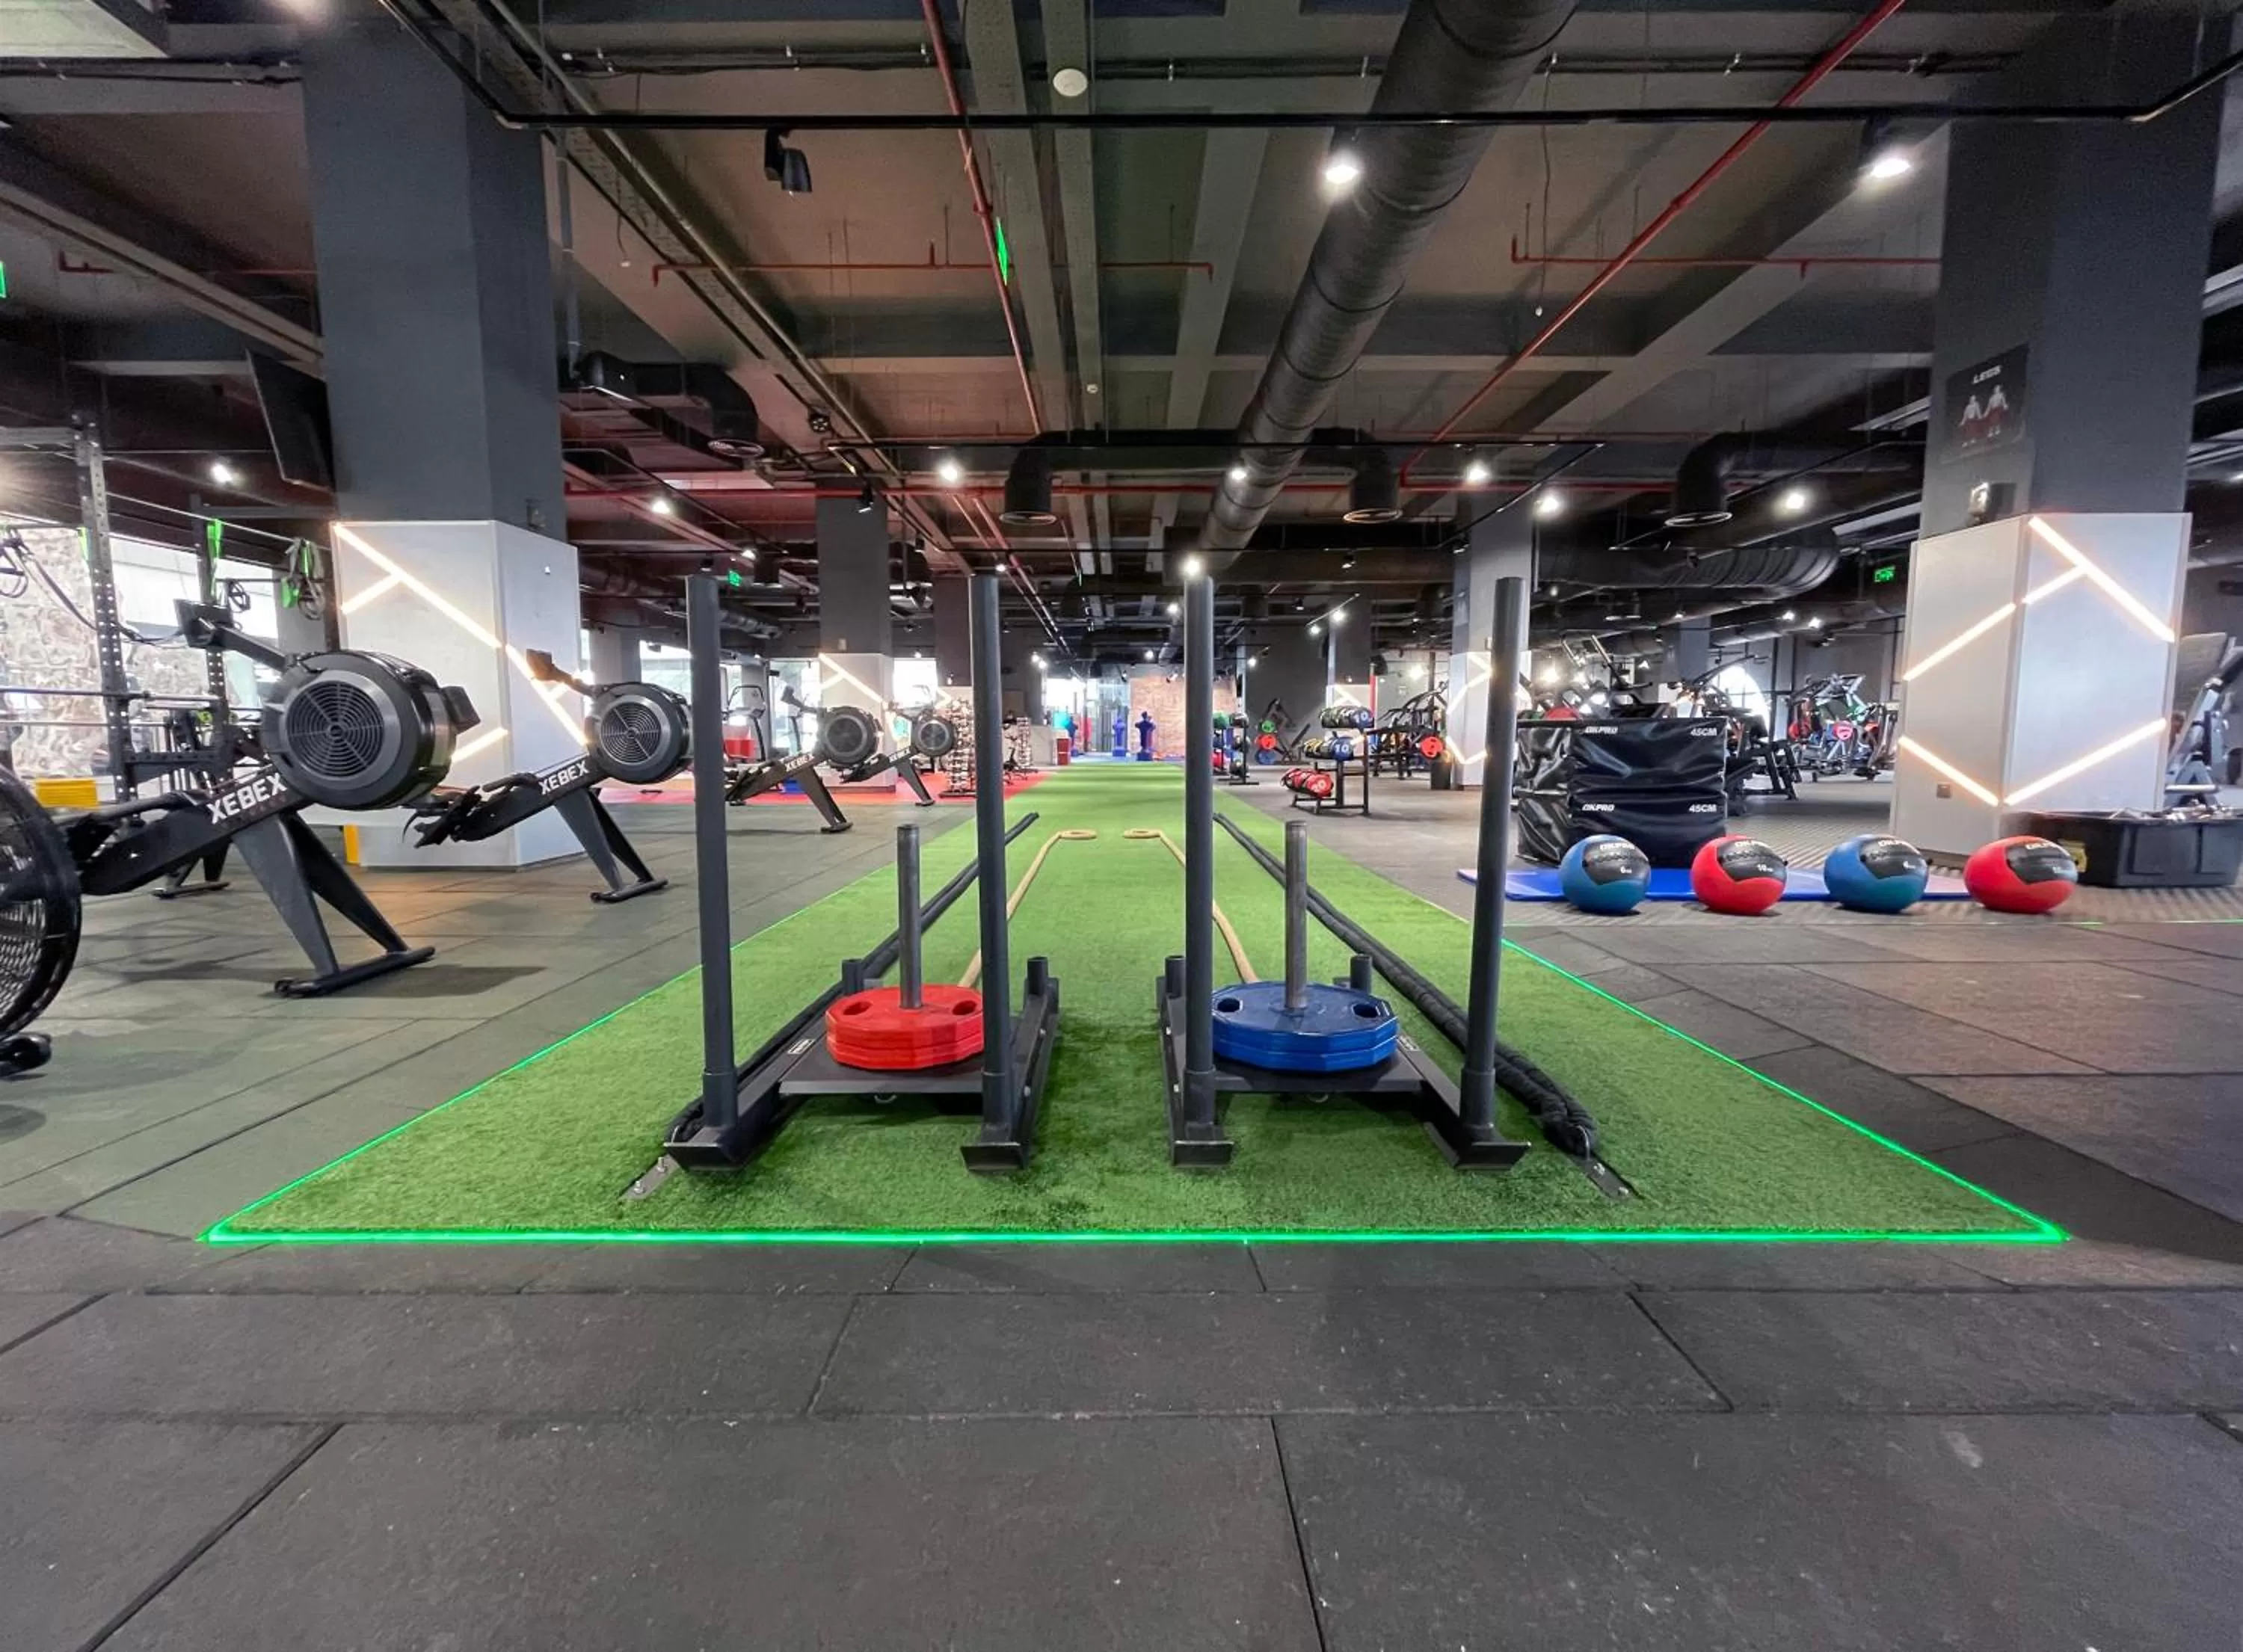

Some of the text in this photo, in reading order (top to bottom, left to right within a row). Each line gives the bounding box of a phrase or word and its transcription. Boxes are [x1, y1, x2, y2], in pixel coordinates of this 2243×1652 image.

[1353, 710, 1368, 724] 10
[1690, 727, 1717, 736] 45CM
[1335, 744, 1350, 753] 10
[538, 759, 589, 795] XEBEX
[206, 772, 287, 825] XEBEX
[1689, 804, 1717, 813] 45CM
